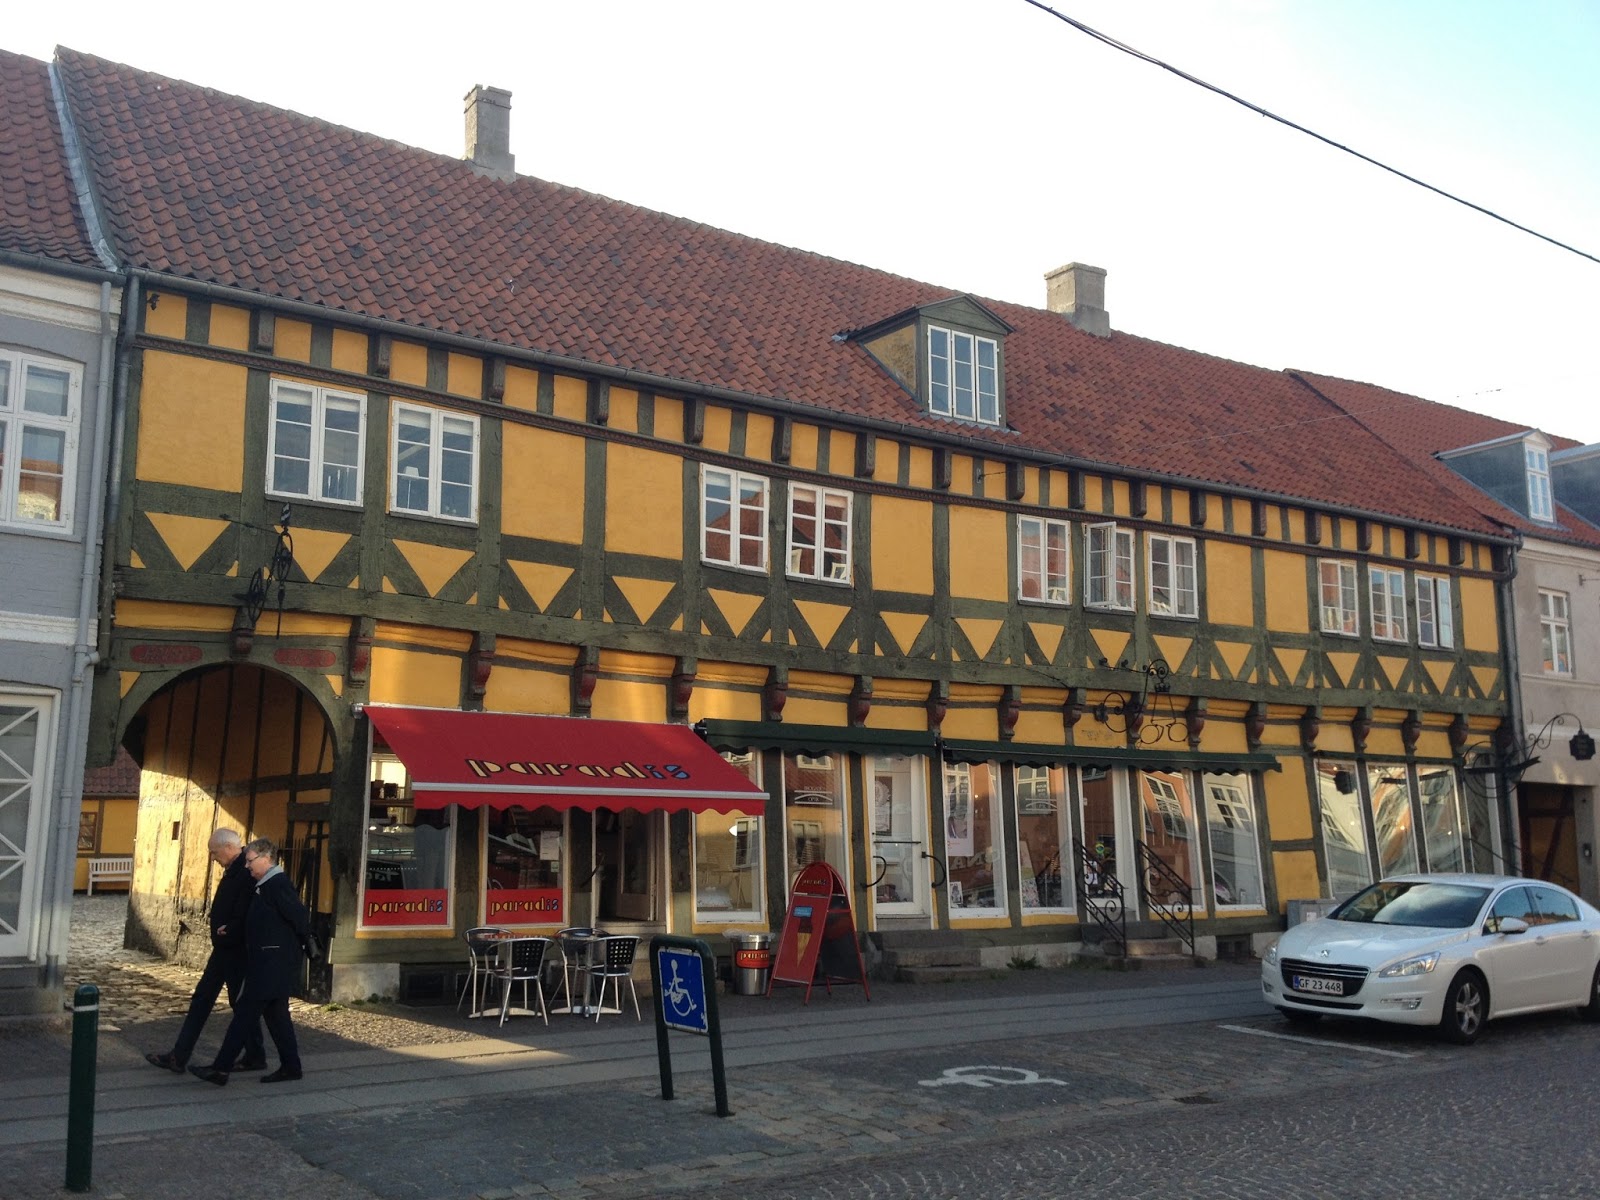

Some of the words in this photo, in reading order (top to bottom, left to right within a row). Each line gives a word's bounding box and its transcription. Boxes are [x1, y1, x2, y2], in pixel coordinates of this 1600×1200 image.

[465, 758, 691, 780] paradis
[368, 898, 444, 917] paradis
[490, 897, 559, 916] paradis
[1299, 978, 1310, 988] GF
[1312, 980, 1323, 990] 23
[1325, 981, 1342, 992] 448
